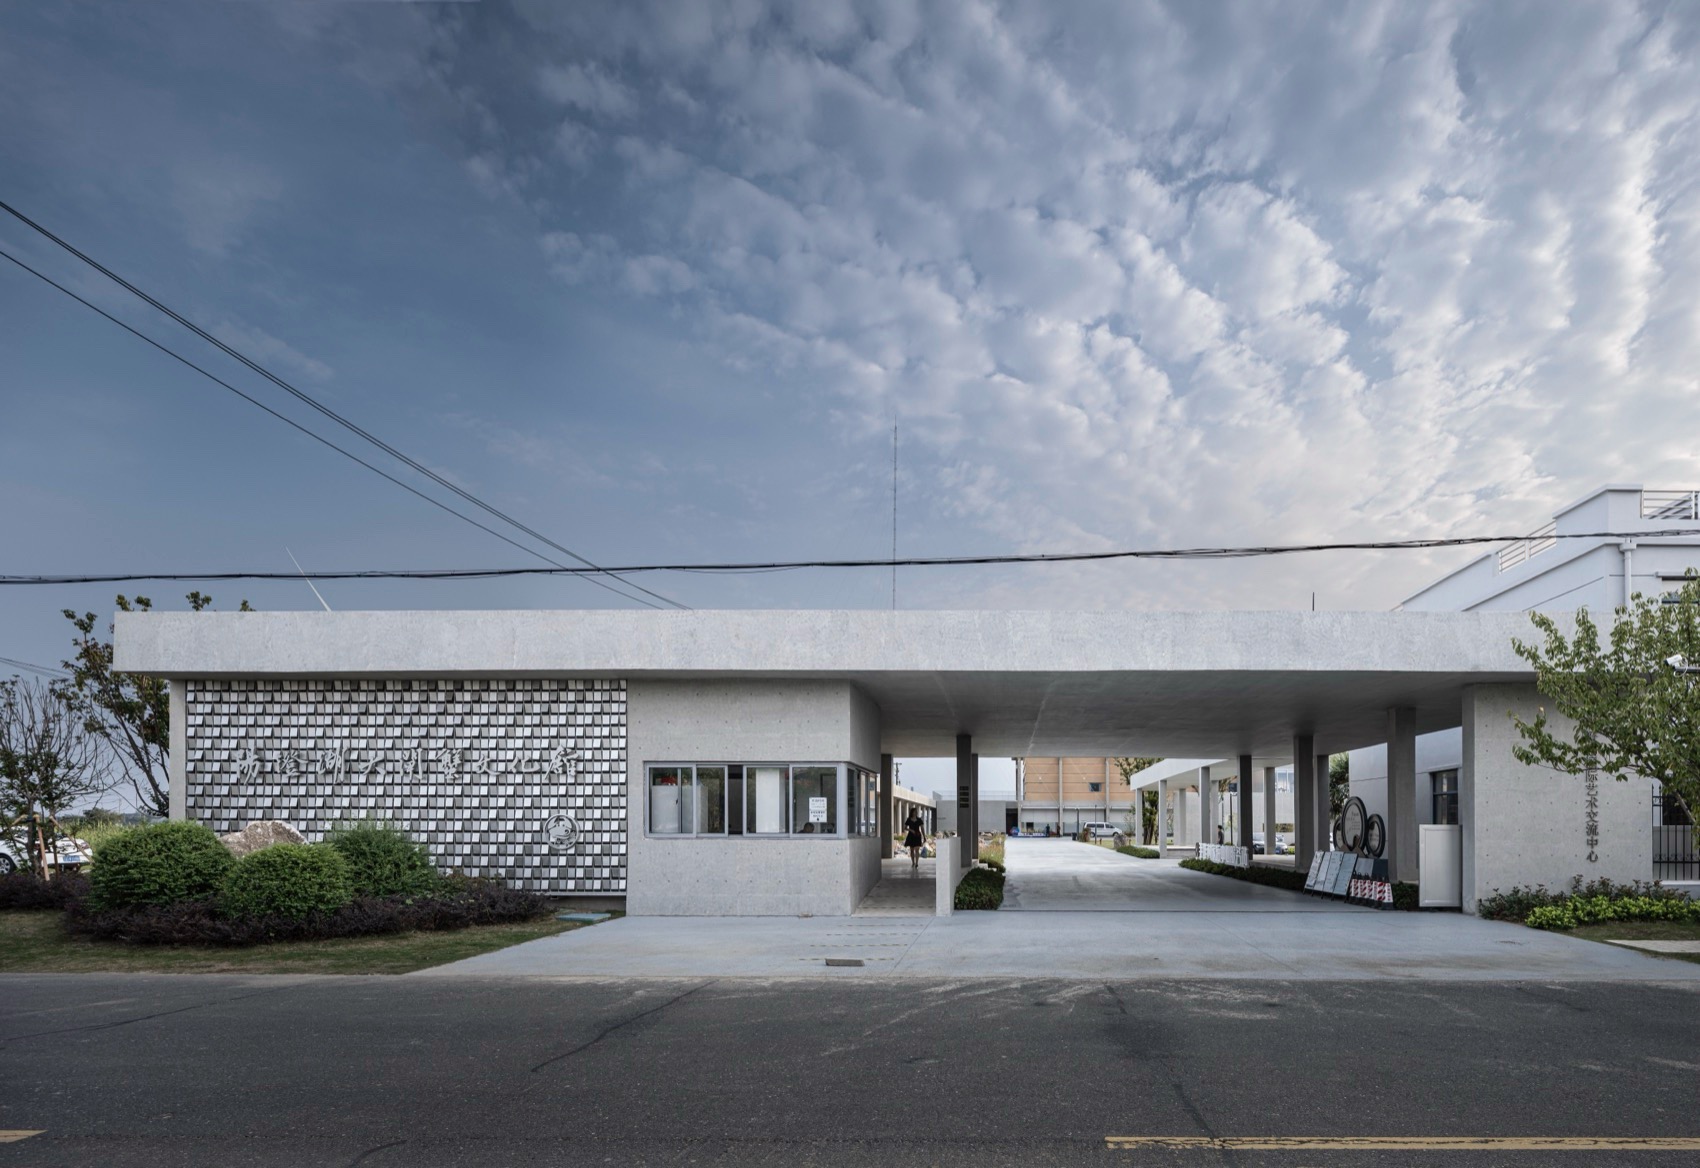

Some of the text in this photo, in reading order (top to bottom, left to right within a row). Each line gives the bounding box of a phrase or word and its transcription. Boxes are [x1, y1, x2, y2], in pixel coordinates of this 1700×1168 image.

[1585, 754, 1599, 862] 际艺术交流中心
